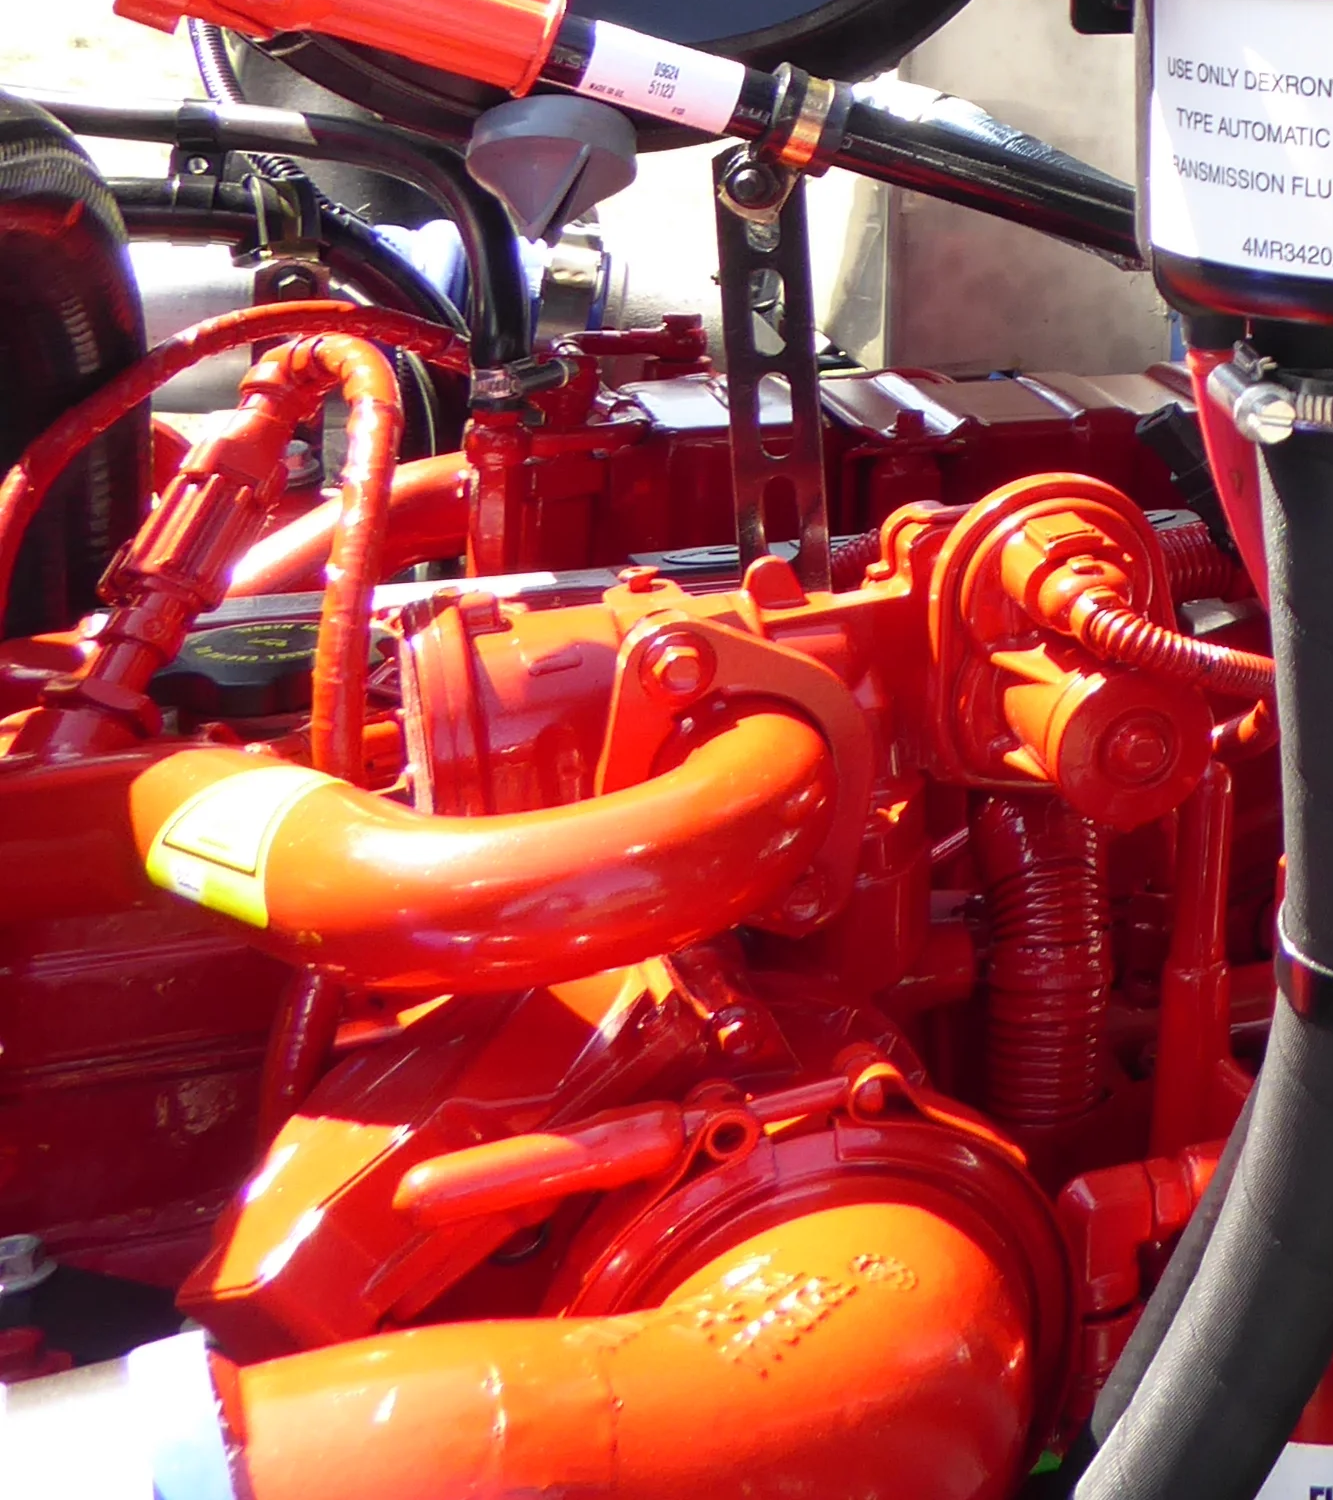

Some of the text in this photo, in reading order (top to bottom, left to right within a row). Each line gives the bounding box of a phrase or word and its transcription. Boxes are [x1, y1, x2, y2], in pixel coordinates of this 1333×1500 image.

[1167, 57, 1193, 80] USE
[1197, 63, 1239, 87] ONLY
[1176, 107, 1331, 149] TYPE AUTOMATIC
[1173, 154, 1285, 194] RANSMISSION
